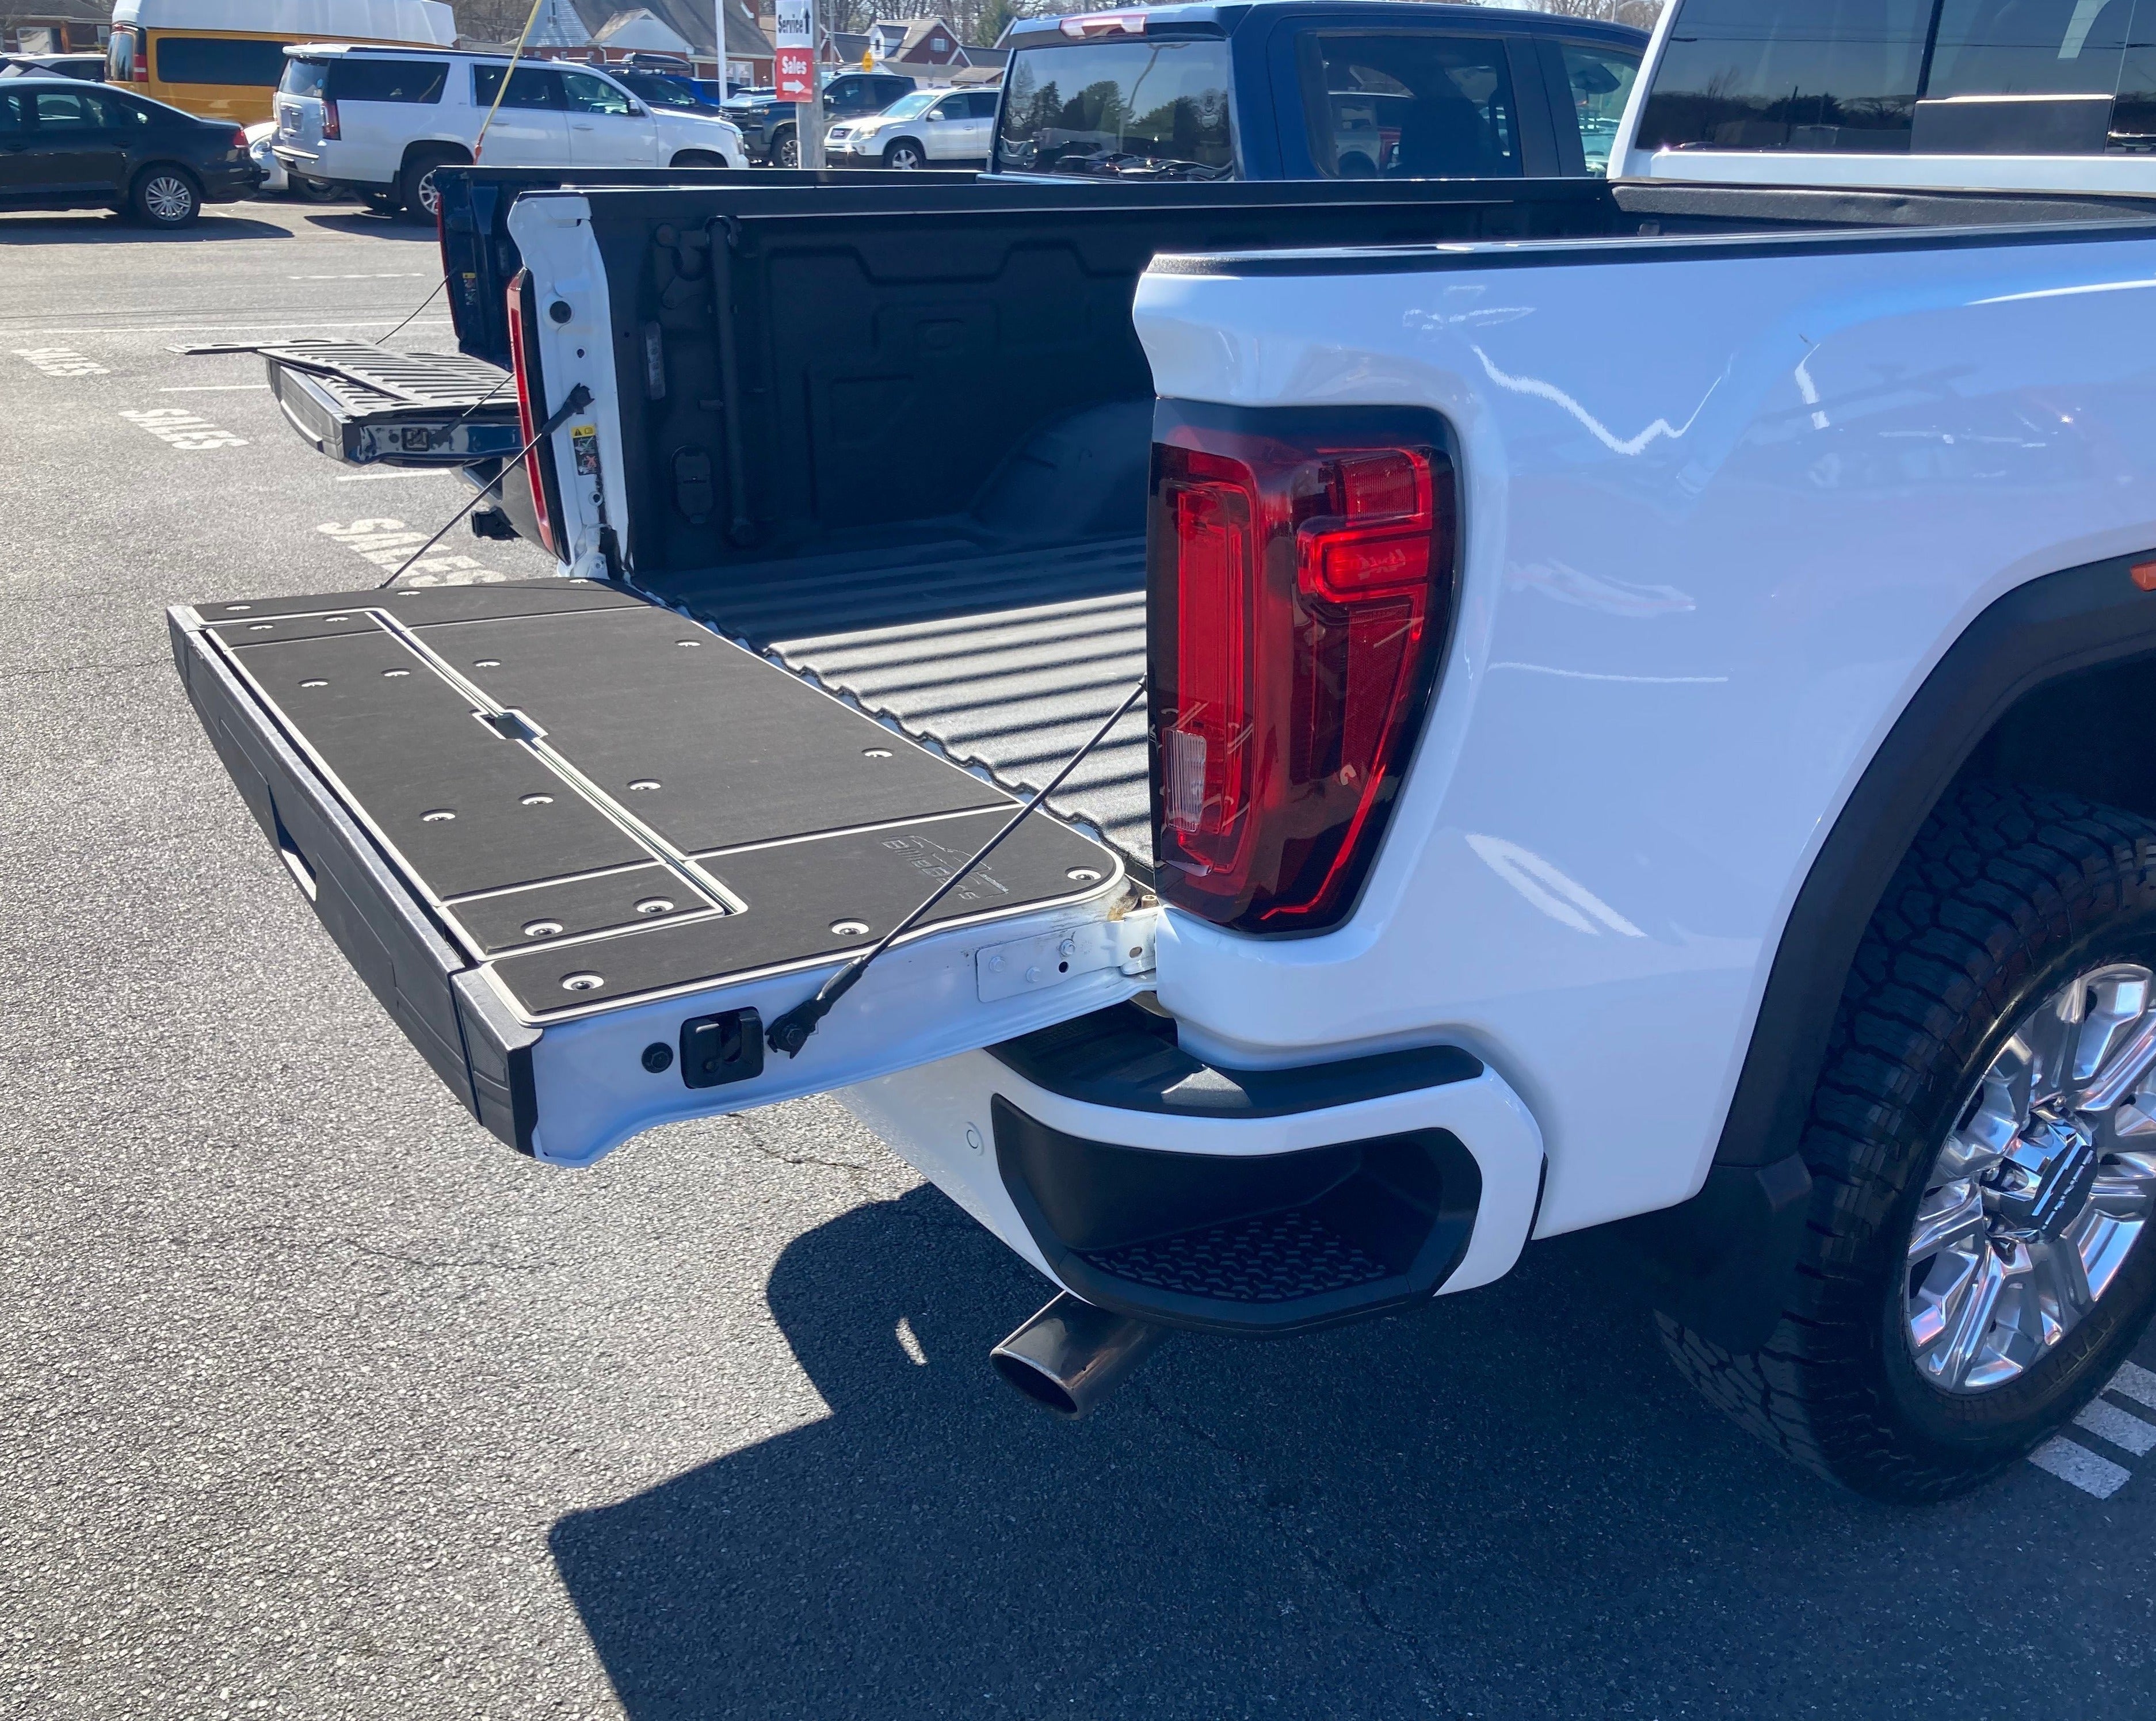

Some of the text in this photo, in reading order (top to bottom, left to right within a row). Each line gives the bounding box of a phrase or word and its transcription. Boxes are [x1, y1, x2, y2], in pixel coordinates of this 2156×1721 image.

[779, 14, 803, 33] Service
[781, 56, 807, 75] Sales
[118, 409, 250, 449] SALES
[316, 518, 506, 587] SALES
